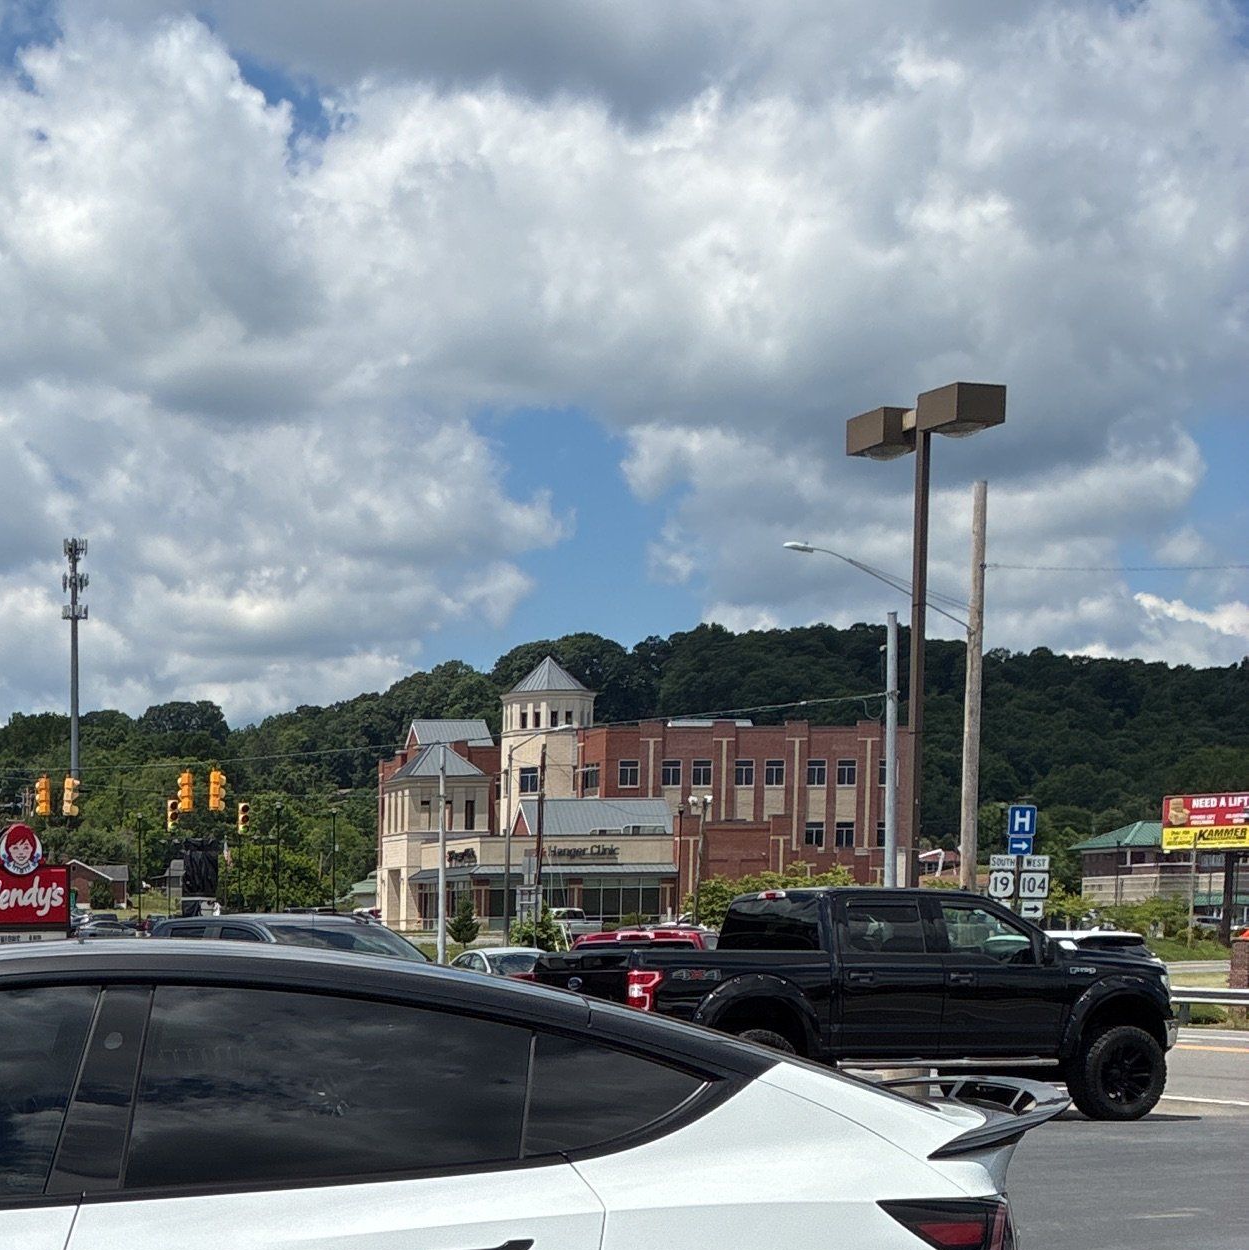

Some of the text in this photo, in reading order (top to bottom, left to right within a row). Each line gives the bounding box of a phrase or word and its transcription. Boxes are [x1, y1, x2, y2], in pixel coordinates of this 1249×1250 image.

[1192, 797, 1217, 809] NEED
[1219, 796, 1227, 807] A
[1014, 810, 1030, 831] H
[1197, 828, 1248, 841] KAMMER
[590, 844, 620, 856] Clinic
[991, 857, 1016, 867] SOUTH
[1026, 858, 1047, 867] WEST
[993, 876, 1010, 892] 19
[1022, 877, 1046, 893] 104
